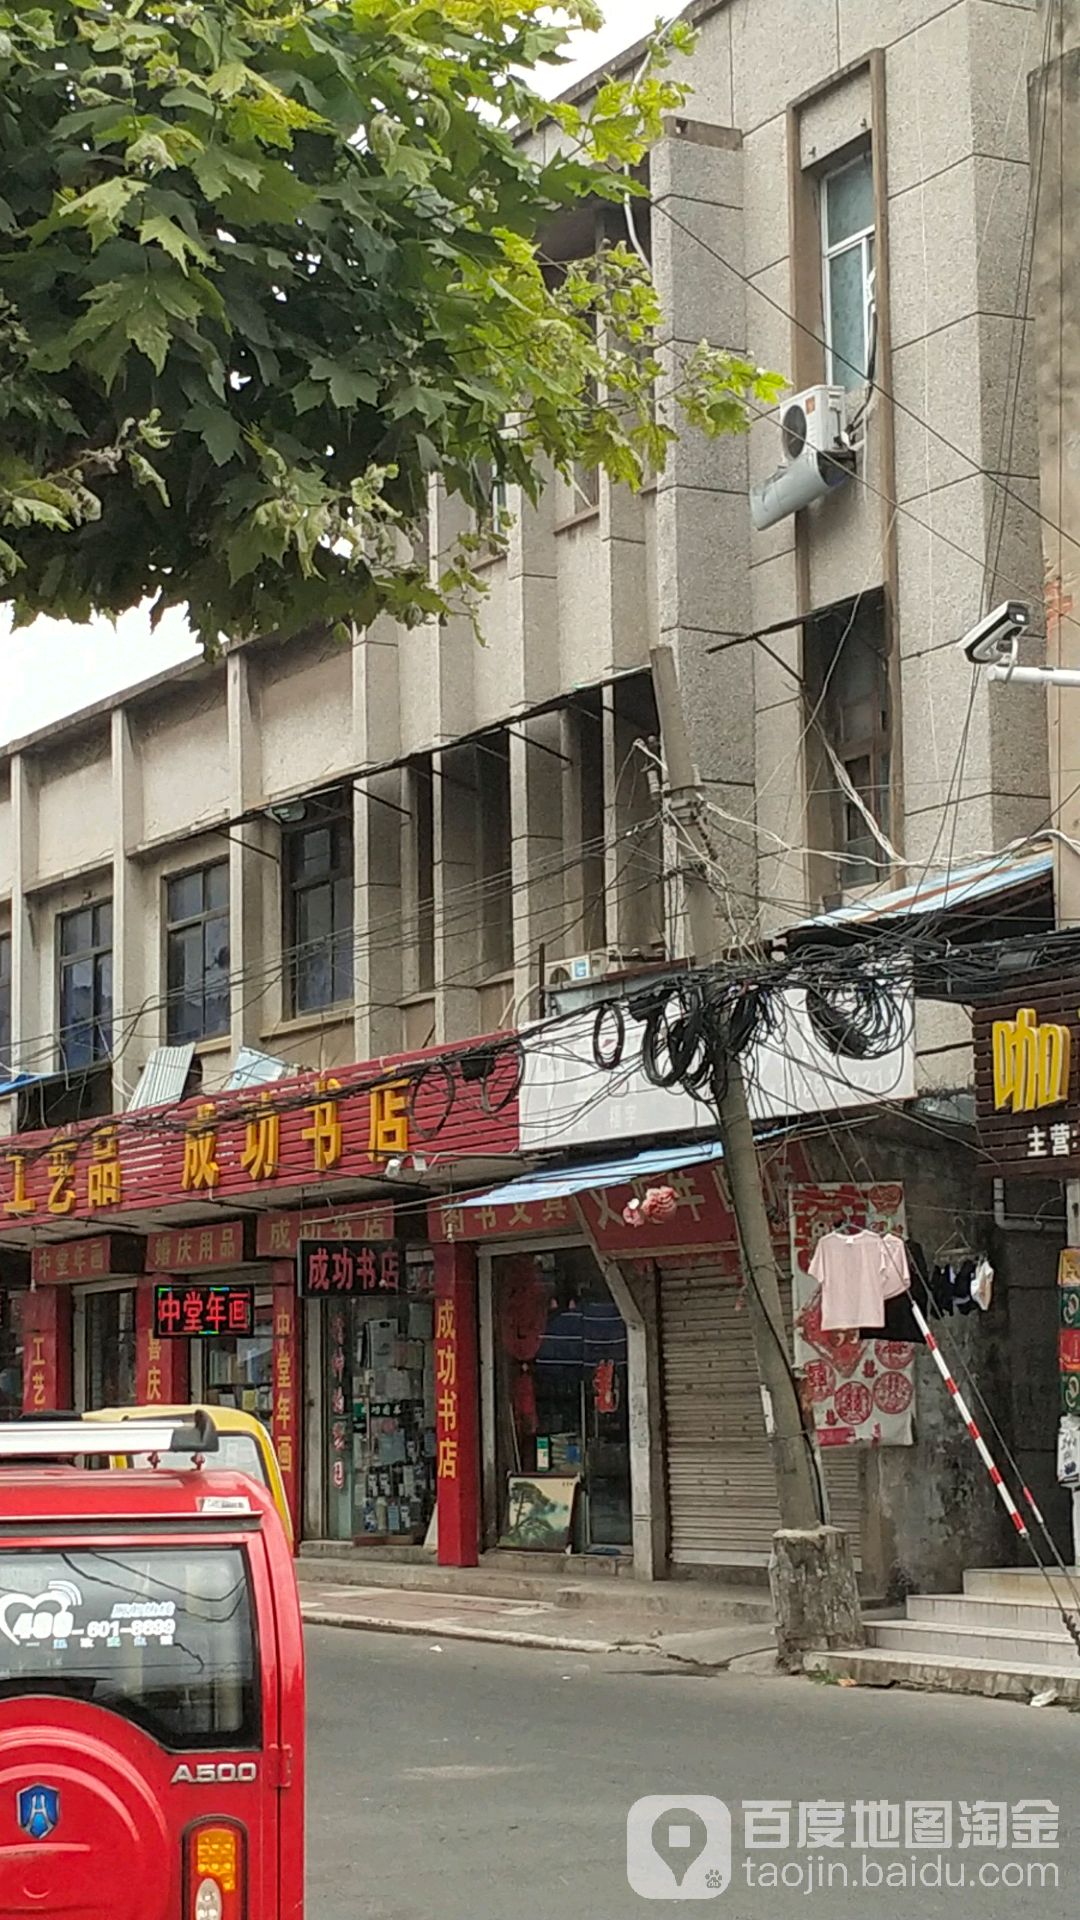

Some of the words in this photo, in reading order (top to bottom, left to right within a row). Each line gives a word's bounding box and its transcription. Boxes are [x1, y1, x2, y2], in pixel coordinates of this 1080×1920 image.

[992, 1008, 1070, 1113] 咖
[3, 1126, 121, 1214] 工艺品
[181, 1066, 412, 1191] 成功书店
[37, 1242, 104, 1278] 中堂年画
[154, 1228, 235, 1266] 婚庆用品
[308, 1247, 400, 1291] 成功书店
[159, 1291, 250, 1332] 中堂年画
[31, 1337, 46, 1411] 工艺
[275, 1308, 293, 1473] 中堂年画
[436, 1301, 459, 1480] 成功书店
[170, 1762, 257, 1784] A500
